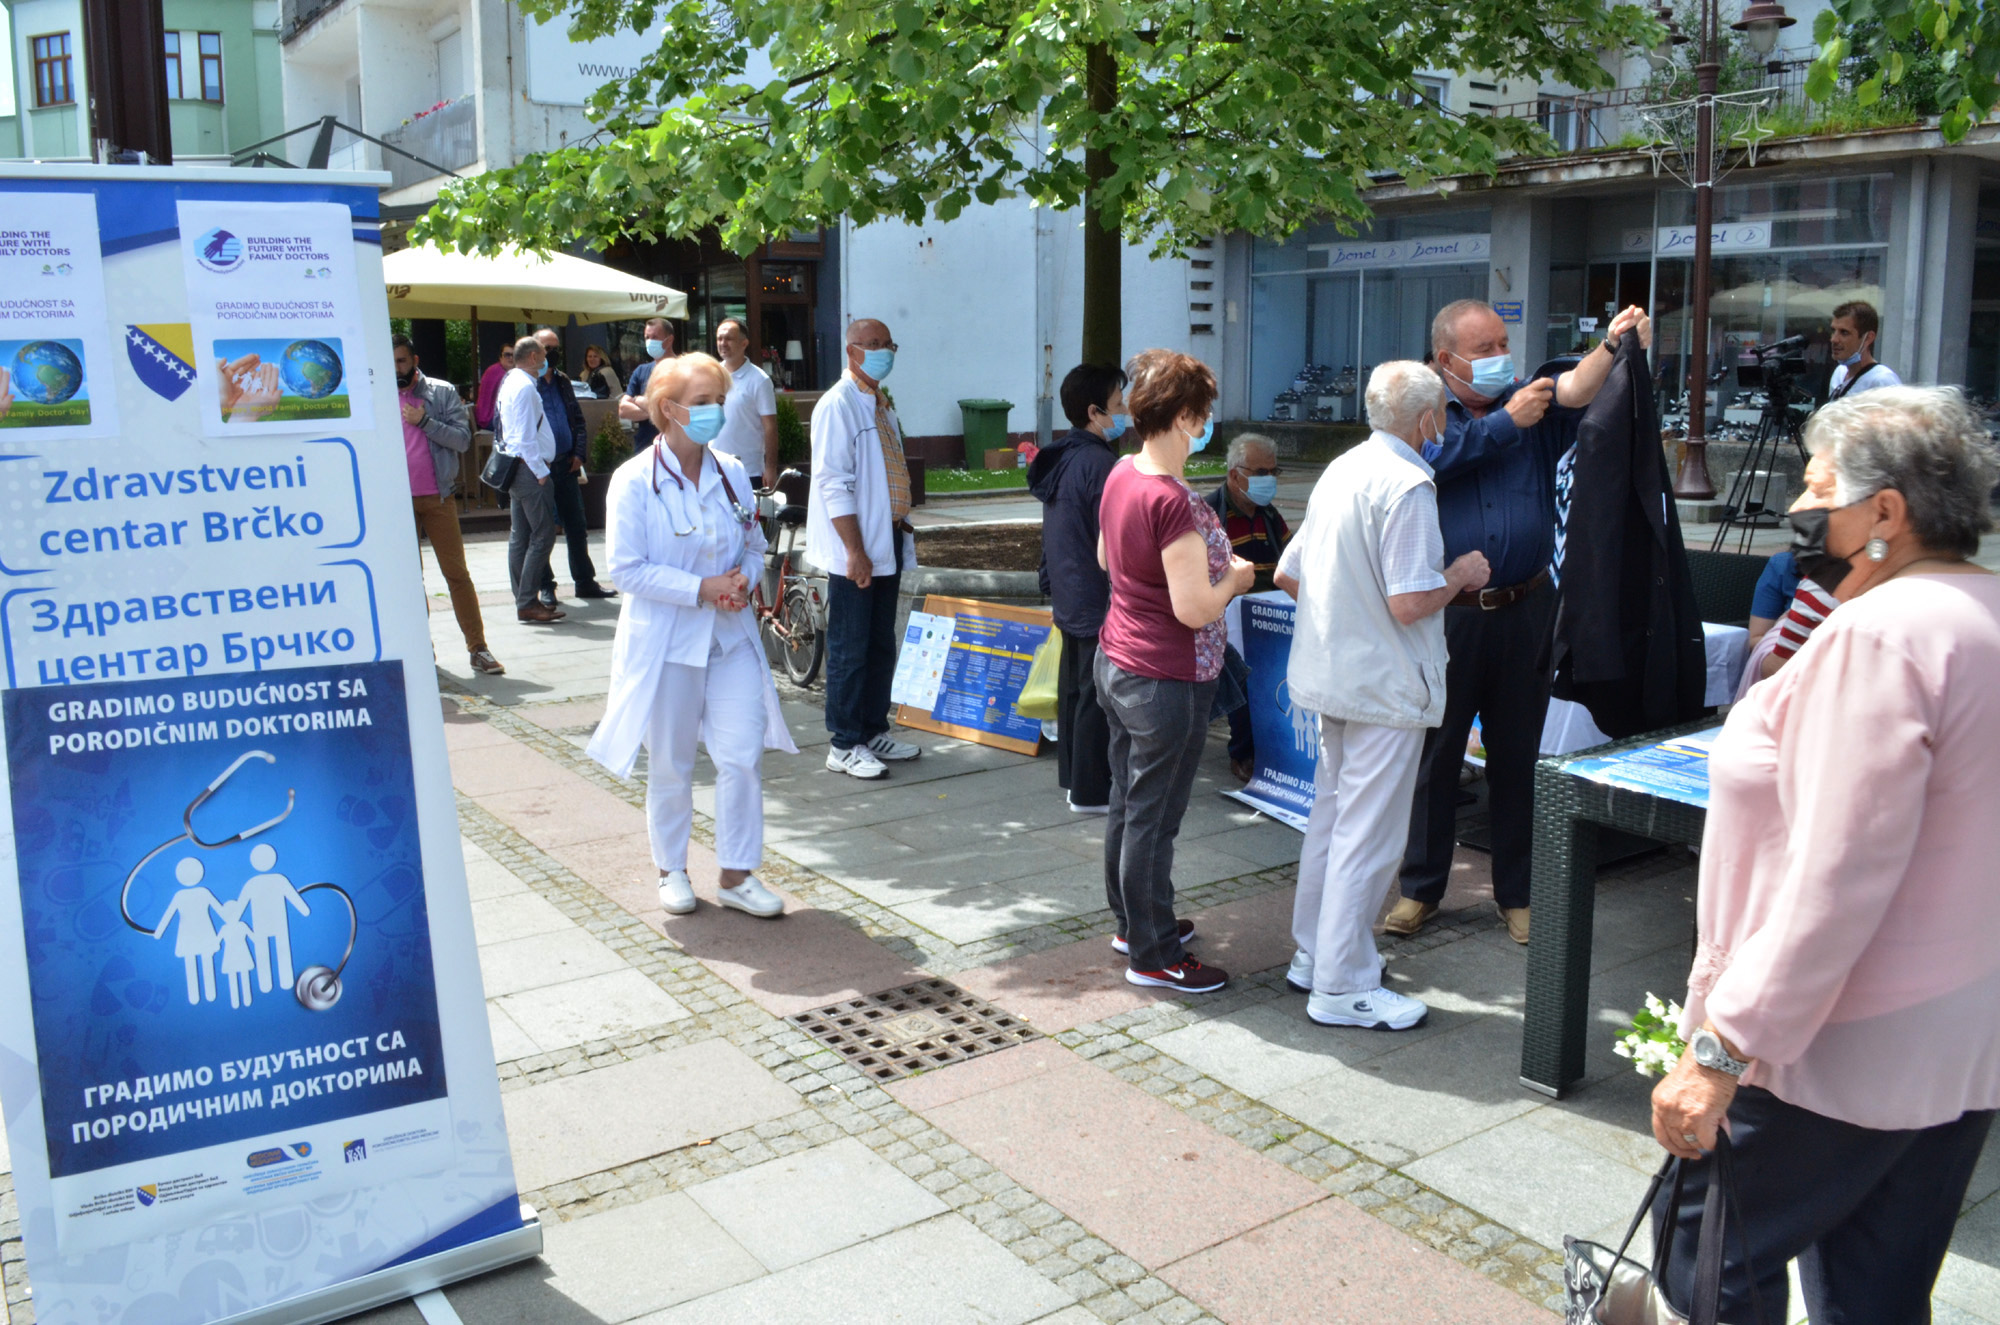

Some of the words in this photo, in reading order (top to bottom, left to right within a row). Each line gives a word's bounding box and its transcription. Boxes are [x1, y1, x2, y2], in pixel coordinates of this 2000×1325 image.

[1662, 230, 1727, 250] Boel
[20, 248, 70, 256] DOCTORS
[61, 300, 75, 308] SA
[215, 301, 260, 310] GRADIMO
[322, 301, 334, 310] SA
[12, 310, 75, 320] DOKTORIMA
[217, 310, 278, 320] PORODIČNIM
[280, 311, 335, 320] DOKTORIMA
[38, 408, 66, 416] Doctor
[276, 404, 300, 412] Family
[304, 402, 329, 410] Doctor
[43, 455, 307, 504] Zdravstveni
[39, 519, 188, 556] centar
[202, 505, 324, 543] Brčko
[30, 580, 337, 638] Здравствени
[1251, 604, 1289, 620] GRADIMO
[37, 640, 208, 686] центар
[222, 626, 355, 671] Брчко
[48, 692, 176, 723] GRADIMO
[182, 680, 332, 711] BUDUĆNOST
[337, 678, 368, 698] SA
[50, 720, 219, 755] PORODIČNIM
[225, 707, 373, 740] DOKTORIMA
[1263, 768, 1299, 788] ГРАДИМО
[84, 1066, 213, 1108] ГРАДИМО
[220, 1036, 370, 1083] БУДУЋНОСТ
[376, 1030, 406, 1052] СА
[72, 1088, 264, 1144] ПОРОДИЧНИМ
[270, 1056, 423, 1110] ДОКТОРИМА
